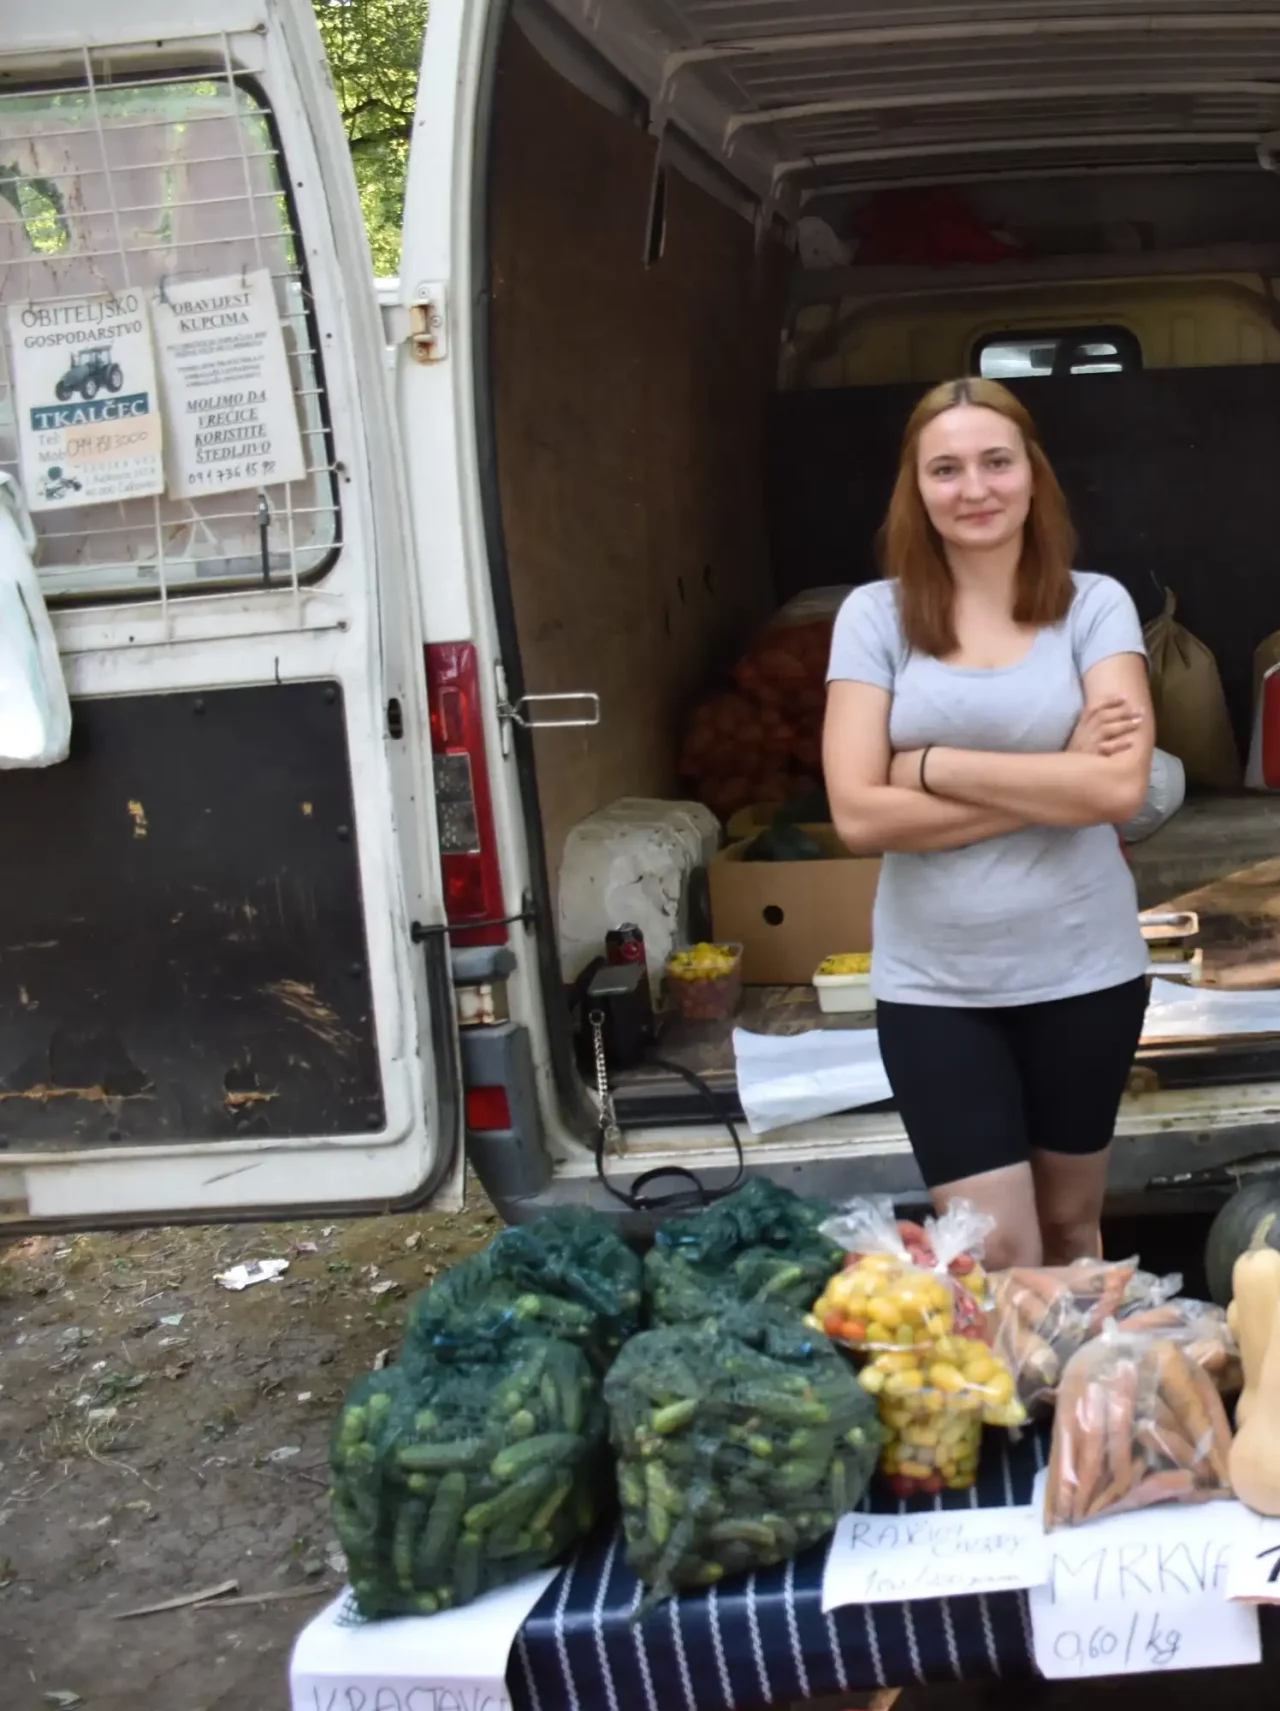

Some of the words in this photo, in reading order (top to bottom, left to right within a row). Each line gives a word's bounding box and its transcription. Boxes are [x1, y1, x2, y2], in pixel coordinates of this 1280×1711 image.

[21, 295, 138, 328] OBITELJSKO
[174, 293, 250, 314] OBAVIJEST
[180, 312, 249, 331] KUPCIMA
[24, 320, 142, 348] GOSPODARSTVO
[187, 393, 243, 411] MOLIMO
[248, 390, 266, 403] DA
[35, 399, 144, 429] TKALČEC
[195, 424, 266, 447] KORISTITE
[196, 440, 271, 463] ŠTEDLJIVO
